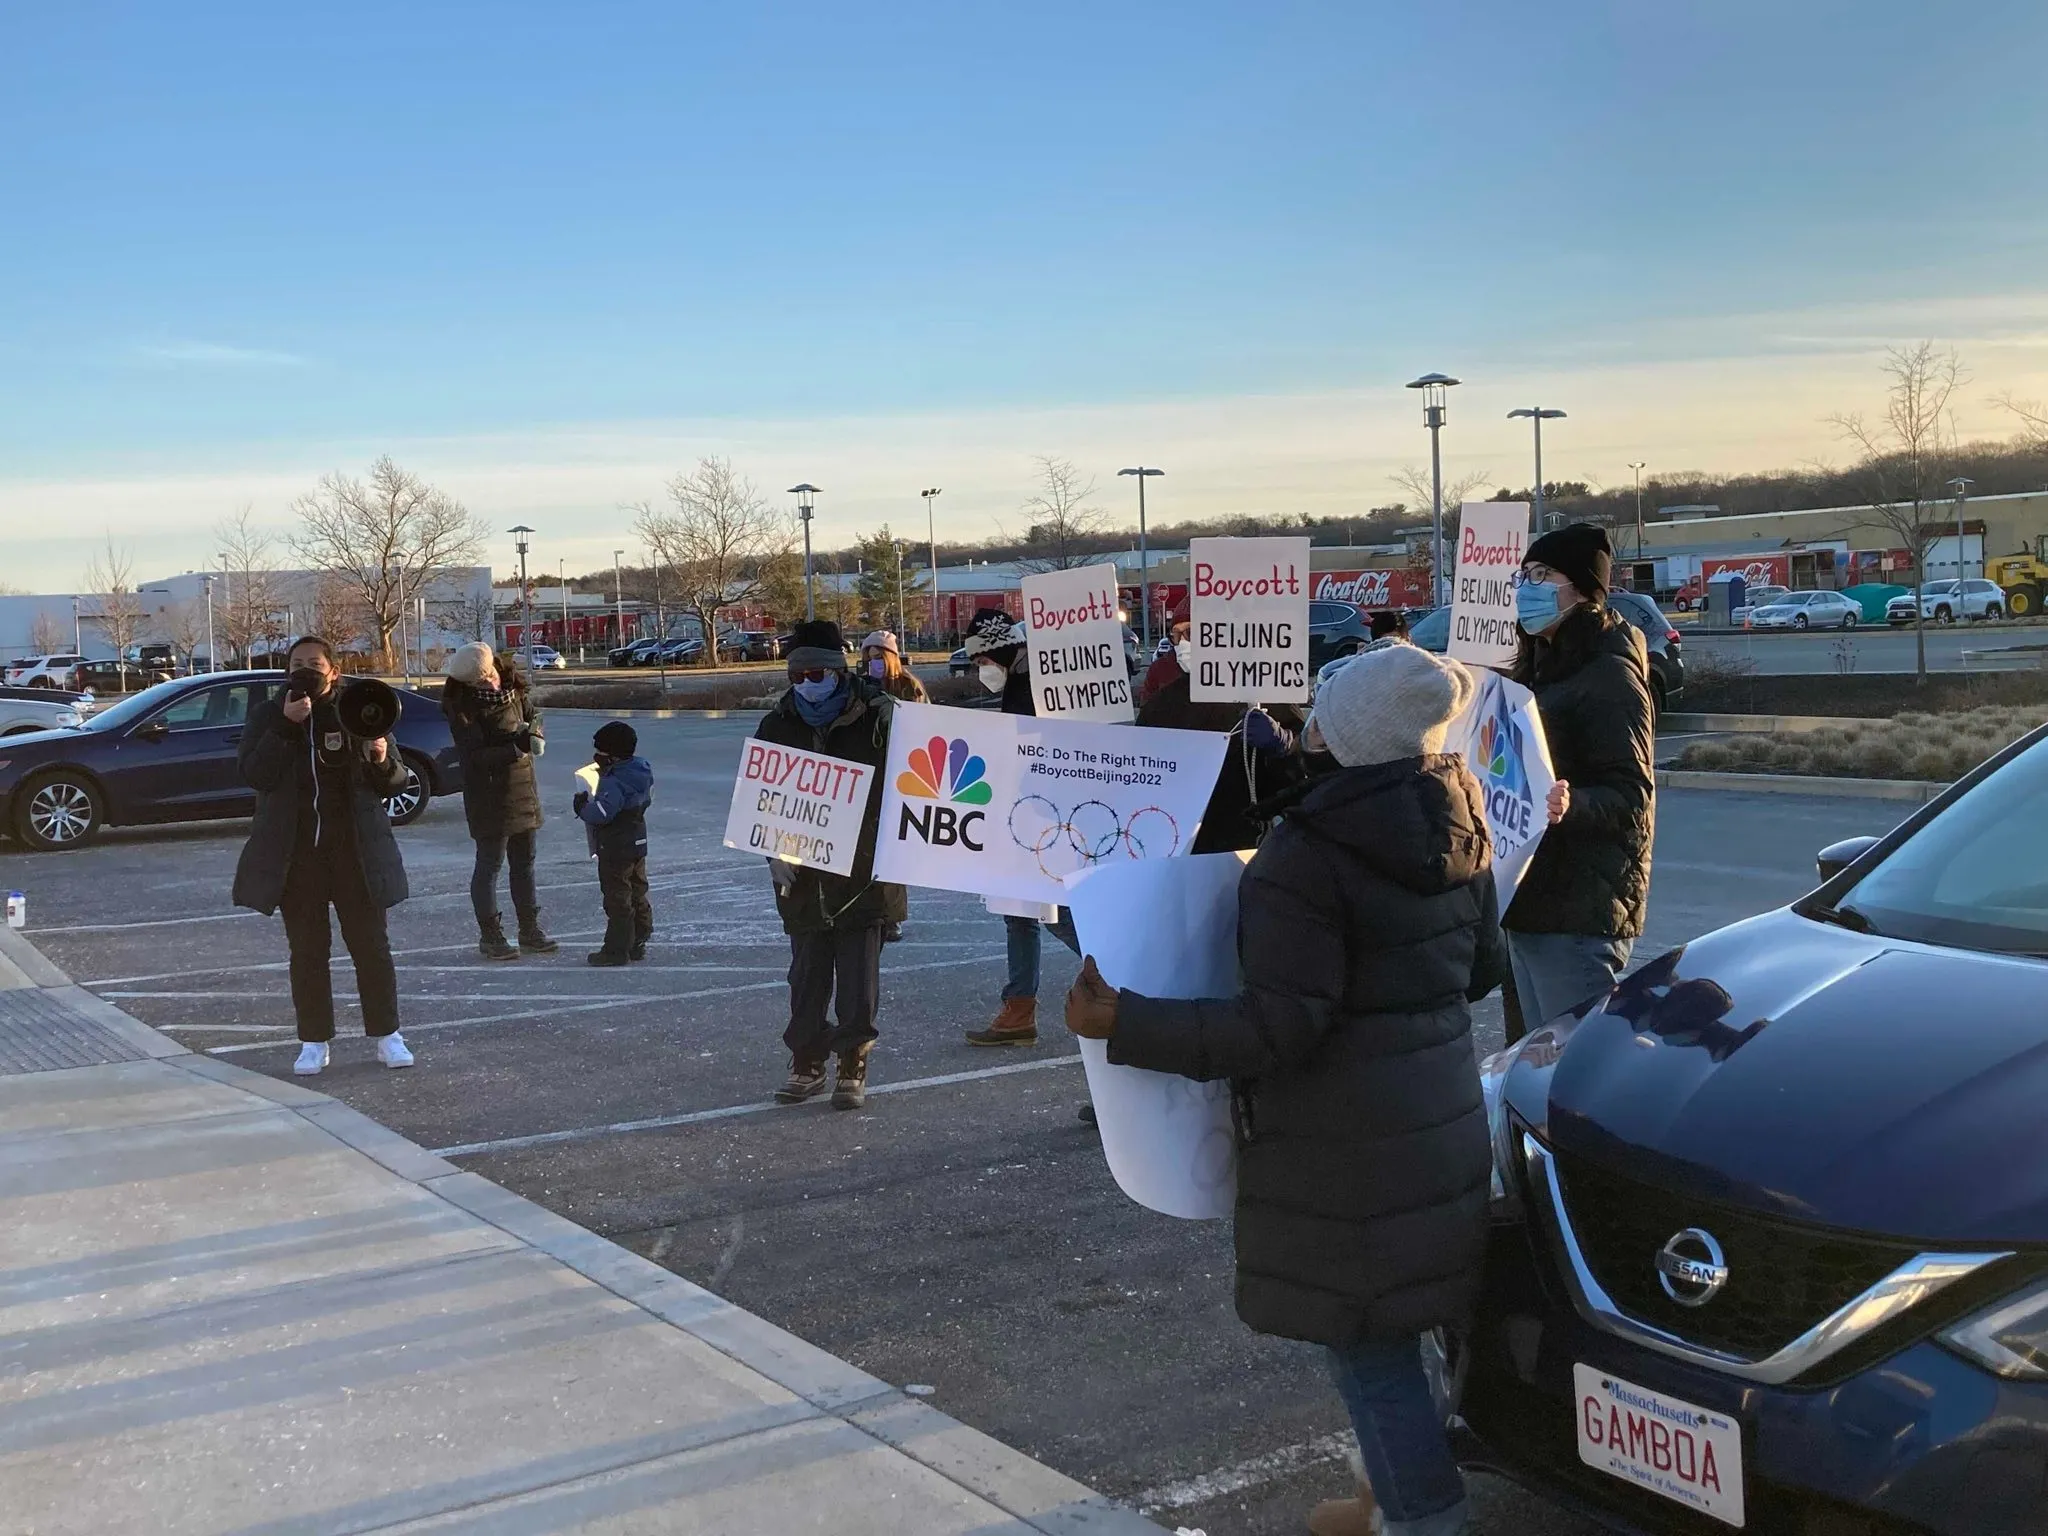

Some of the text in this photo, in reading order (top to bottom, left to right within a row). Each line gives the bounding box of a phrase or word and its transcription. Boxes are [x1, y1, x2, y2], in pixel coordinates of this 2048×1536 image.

[1462, 526, 1521, 566] Boycott
[1195, 563, 1300, 601] Boycott
[1315, 572, 1391, 606] Coca-Cola
[1460, 578, 1513, 607] BEIJING
[1030, 589, 1113, 631] Boycott
[1200, 622, 1292, 649] BEIJING
[1456, 615, 1516, 646] OLYMPICS
[1039, 643, 1113, 676] BEIJING
[1200, 661, 1305, 688] OLYMPICS
[1043, 679, 1128, 712] OLYMPICS
[745, 745, 864, 804] BOYCOTT
[1017, 744, 1177, 773] NBC: Do The Right Thing
[1030, 762, 1162, 786] #BoycottBeijing2022
[757, 788, 832, 828] BEIJING
[1480, 780, 1531, 840] OCIDE
[750, 823, 834, 865] OLYMPICS
[898, 801, 985, 852] NBC
[1608, 1380, 1700, 1430] Massachusetts
[1584, 1395, 1721, 1495] GAMBOA
[1612, 1457, 1628, 1472] The
[1630, 1464, 1652, 1482] Spirit
[1655, 1476, 1664, 1488] of
